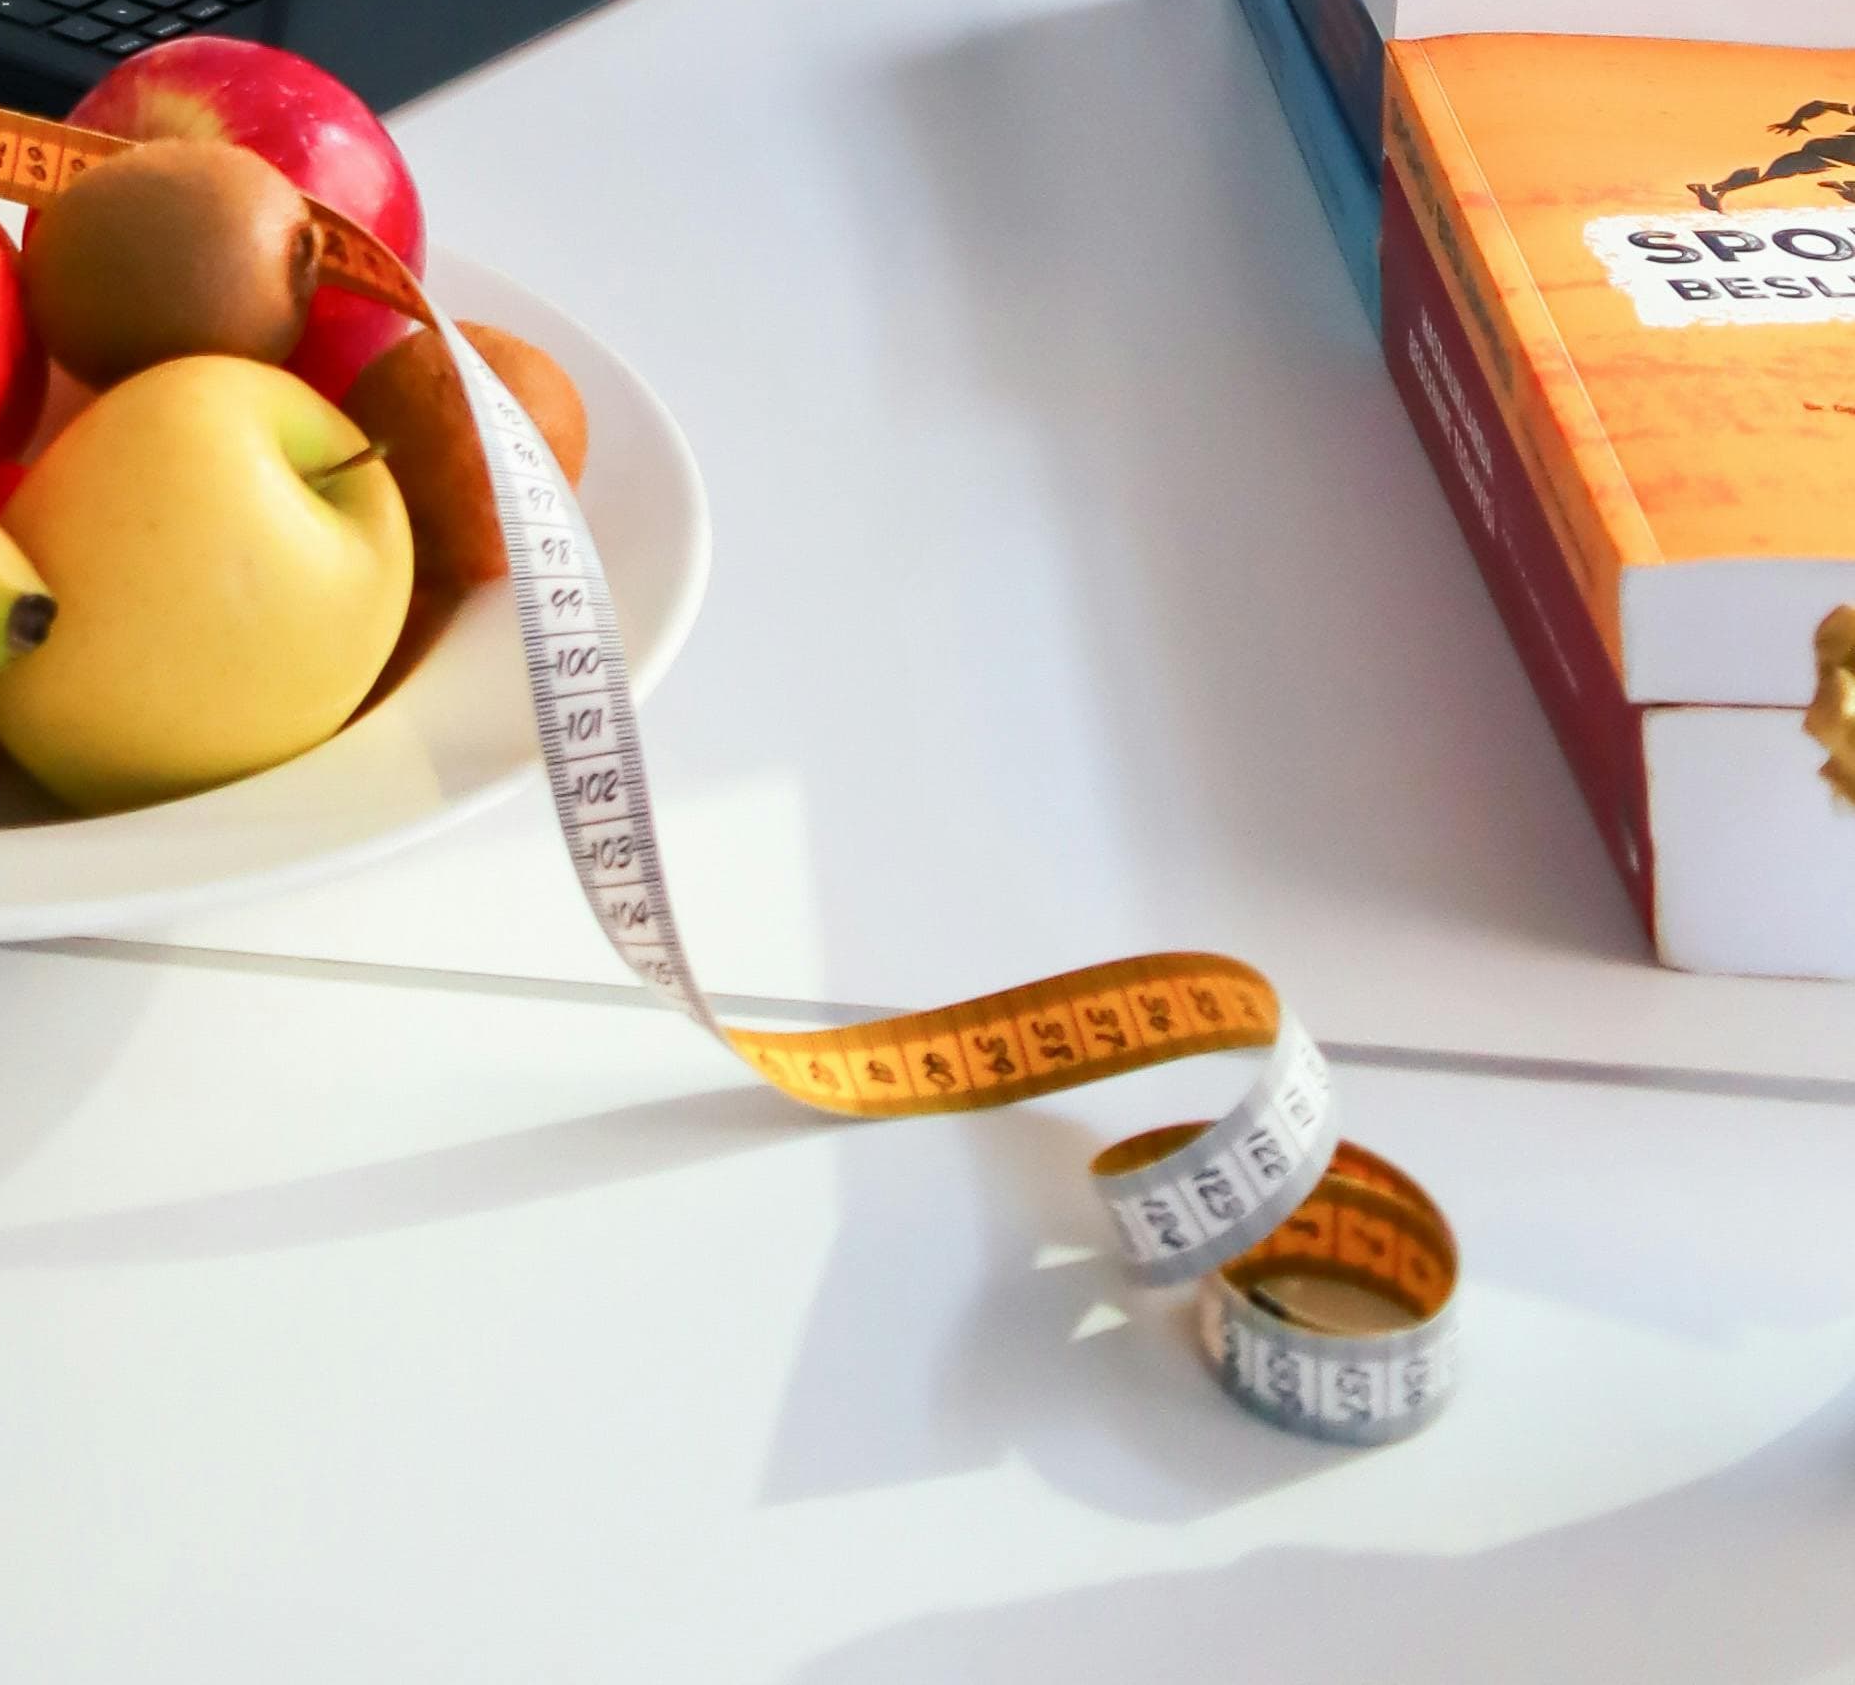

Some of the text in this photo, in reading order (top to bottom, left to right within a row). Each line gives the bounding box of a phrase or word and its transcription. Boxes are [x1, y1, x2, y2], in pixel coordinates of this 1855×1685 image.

[1628, 227, 1855, 264] SPO
[541, 538, 572, 566] 98
[551, 588, 583, 618] 99
[555, 646, 601, 677] 100
[566, 708, 604, 742] 101
[574, 768, 620, 803] 102
[591, 834, 634, 869] 103
[1030, 1021, 1074, 1061] 38
[1084, 1007, 1128, 1048] 37
[973, 1035, 1016, 1076] 39
